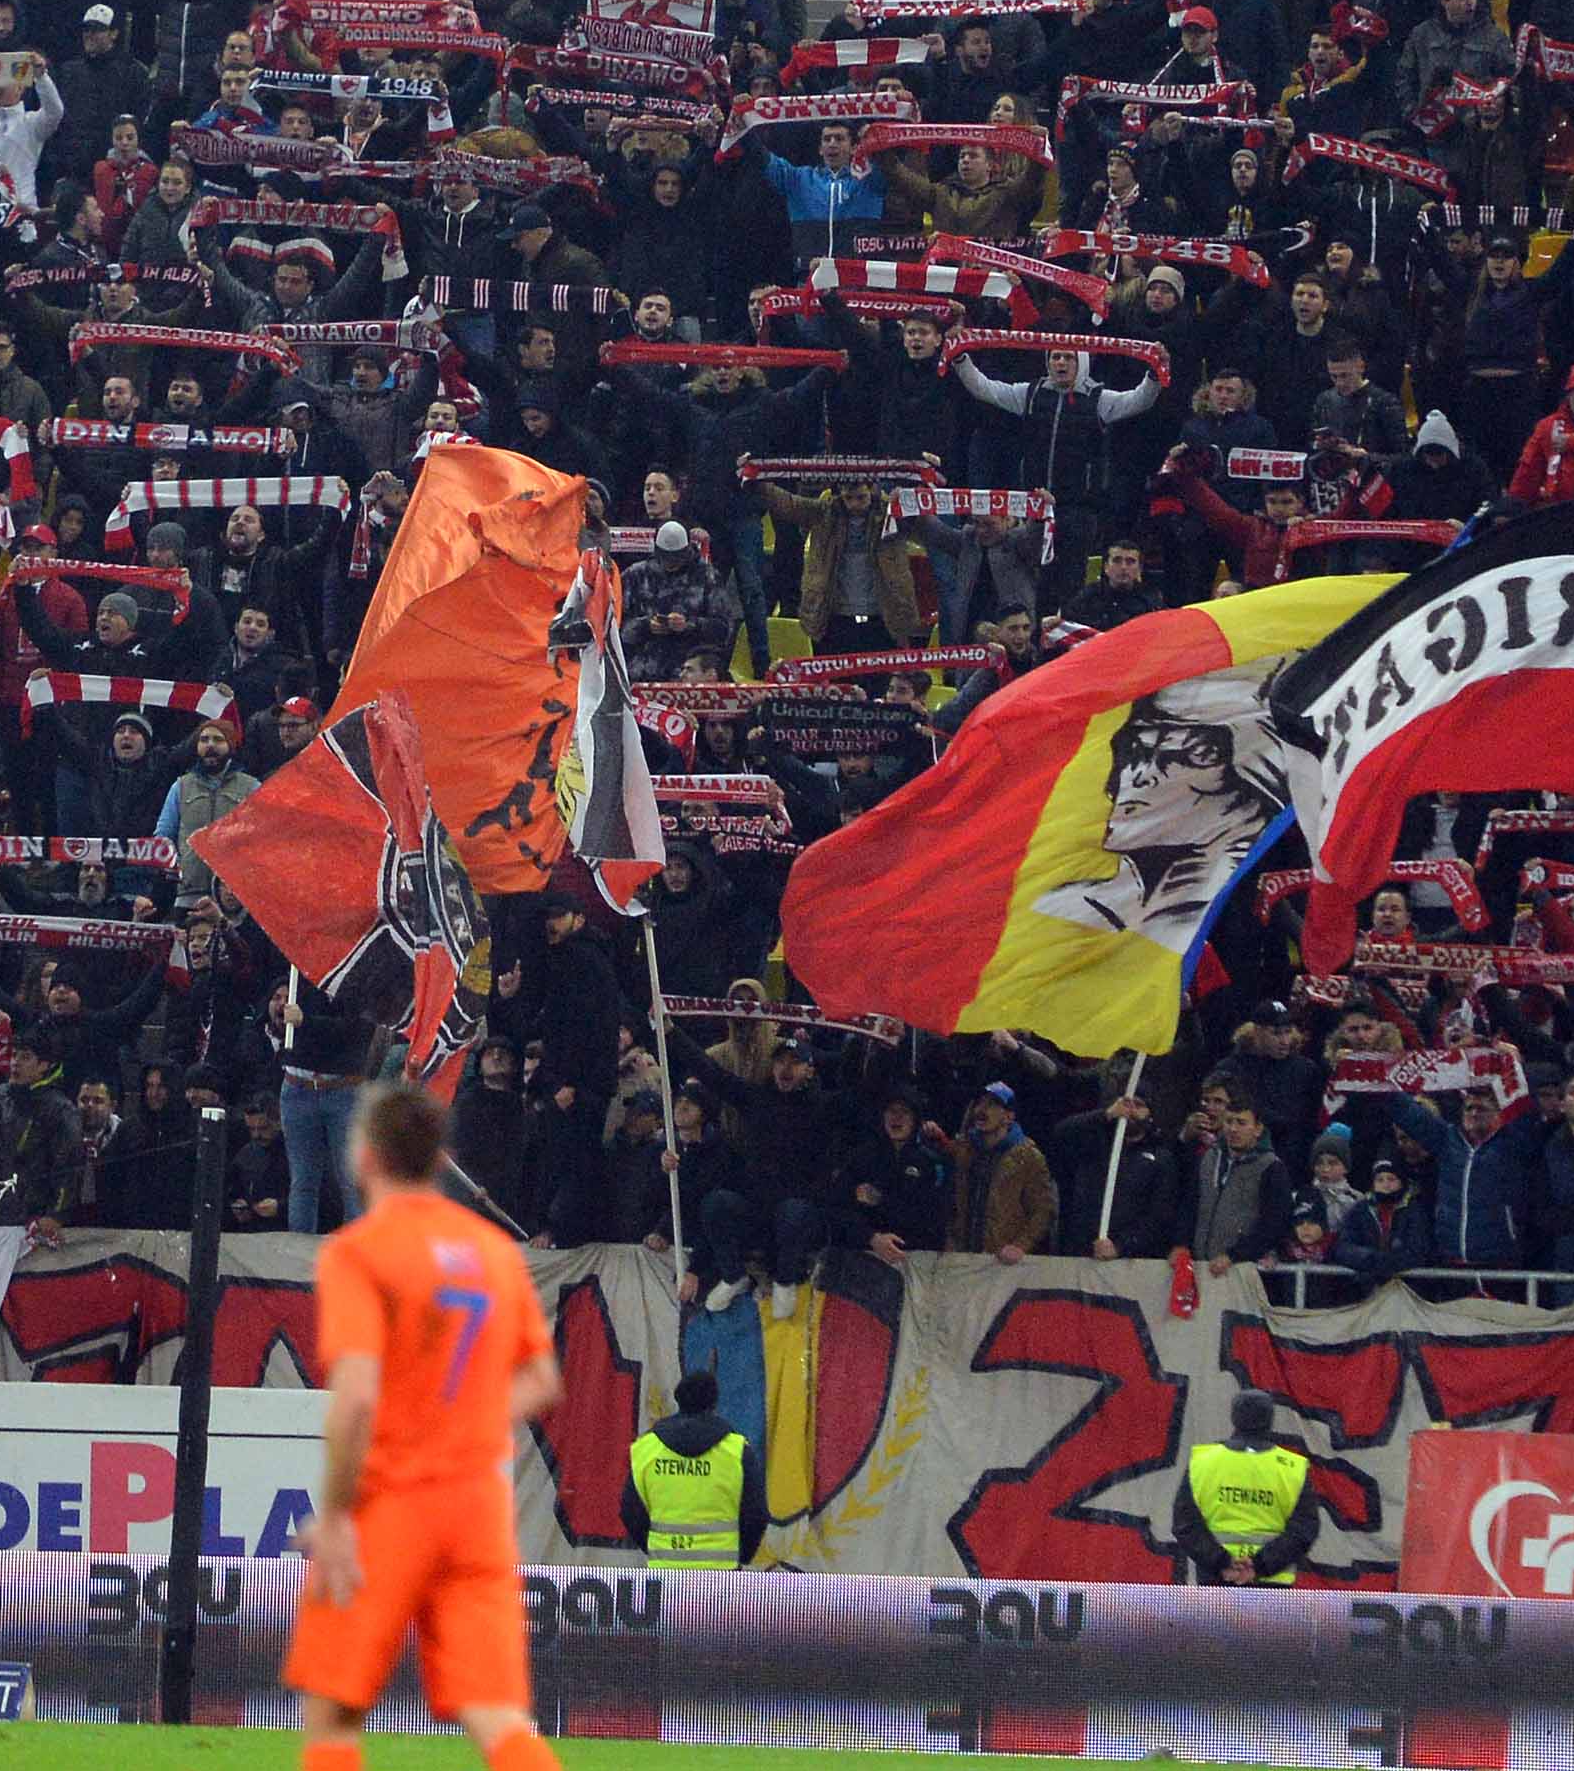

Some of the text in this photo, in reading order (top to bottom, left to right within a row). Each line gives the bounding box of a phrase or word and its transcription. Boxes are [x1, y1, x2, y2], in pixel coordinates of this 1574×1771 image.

[311, 8, 423, 22] DINAMO
[346, 31, 381, 43] DOAR
[384, 33, 435, 45] DINAMO
[537, 54, 689, 84] F.C. DINAMO
[263, 70, 433, 95] DINAMO 1948
[756, 92, 900, 120] DINAMO
[219, 201, 377, 230] DINAMO
[283, 324, 383, 342] DINAMO
[946, 328, 1036, 350] DINAMO
[65, 424, 264, 446] DIN AMO
[801, 648, 987, 675] TOTUL PENTRU DINAMO
[772, 700, 834, 719] Unicul
[774, 728, 899, 741] DOAR DINAMO
[694, 778, 713, 791] LA
[103, 838, 175, 859] AMO
[68, 935, 144, 951] HILDAN
[435, 1288, 493, 1408] 7
[653, 1457, 713, 1478] STEWARD
[1218, 1486, 1274, 1508] STEWARD
